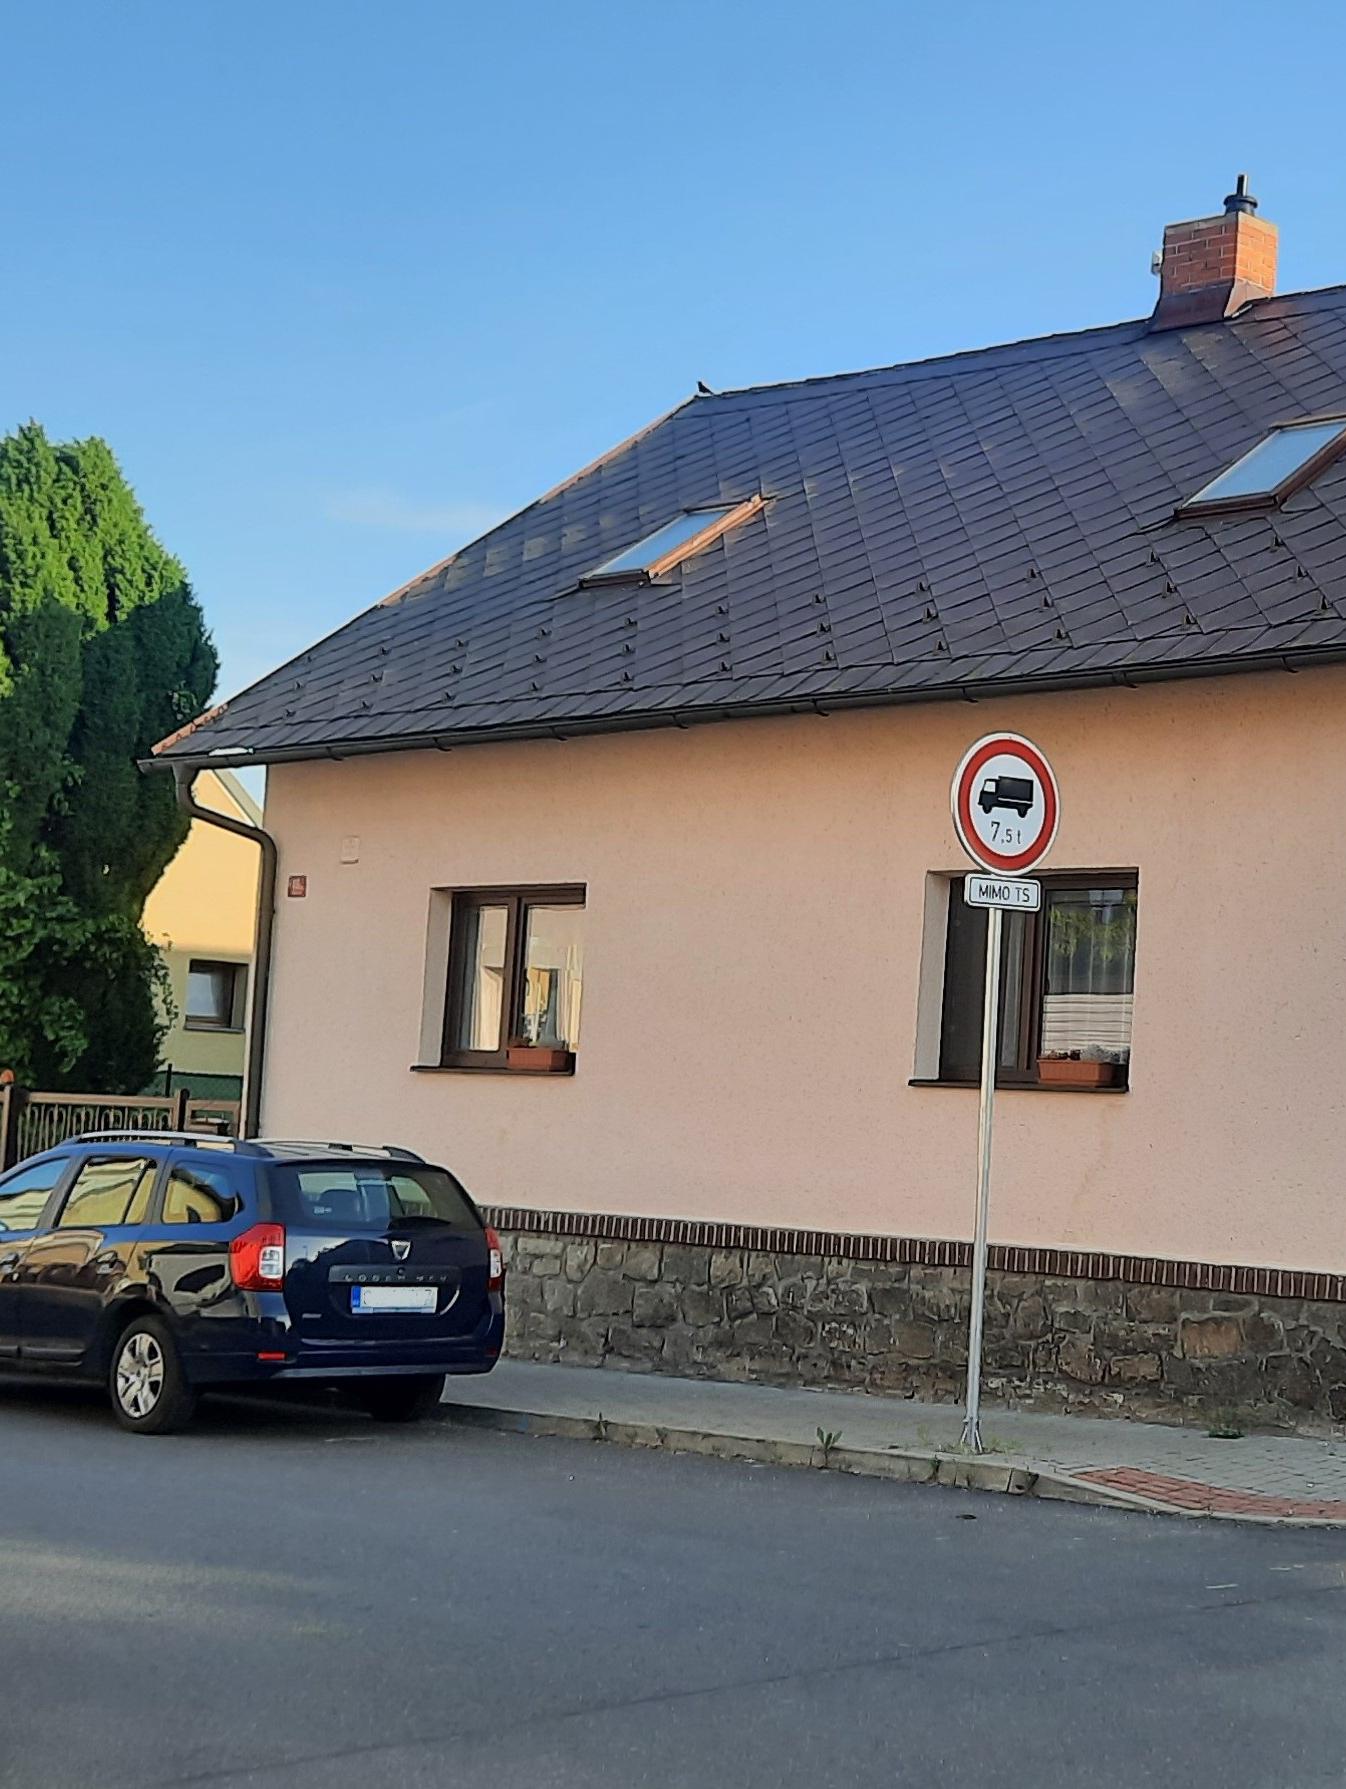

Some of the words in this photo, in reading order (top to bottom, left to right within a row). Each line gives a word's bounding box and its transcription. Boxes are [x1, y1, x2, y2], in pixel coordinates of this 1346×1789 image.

[991, 820, 1013, 844] 7,5
[978, 883, 1010, 901] MIMO
[1014, 886, 1030, 903] TS
